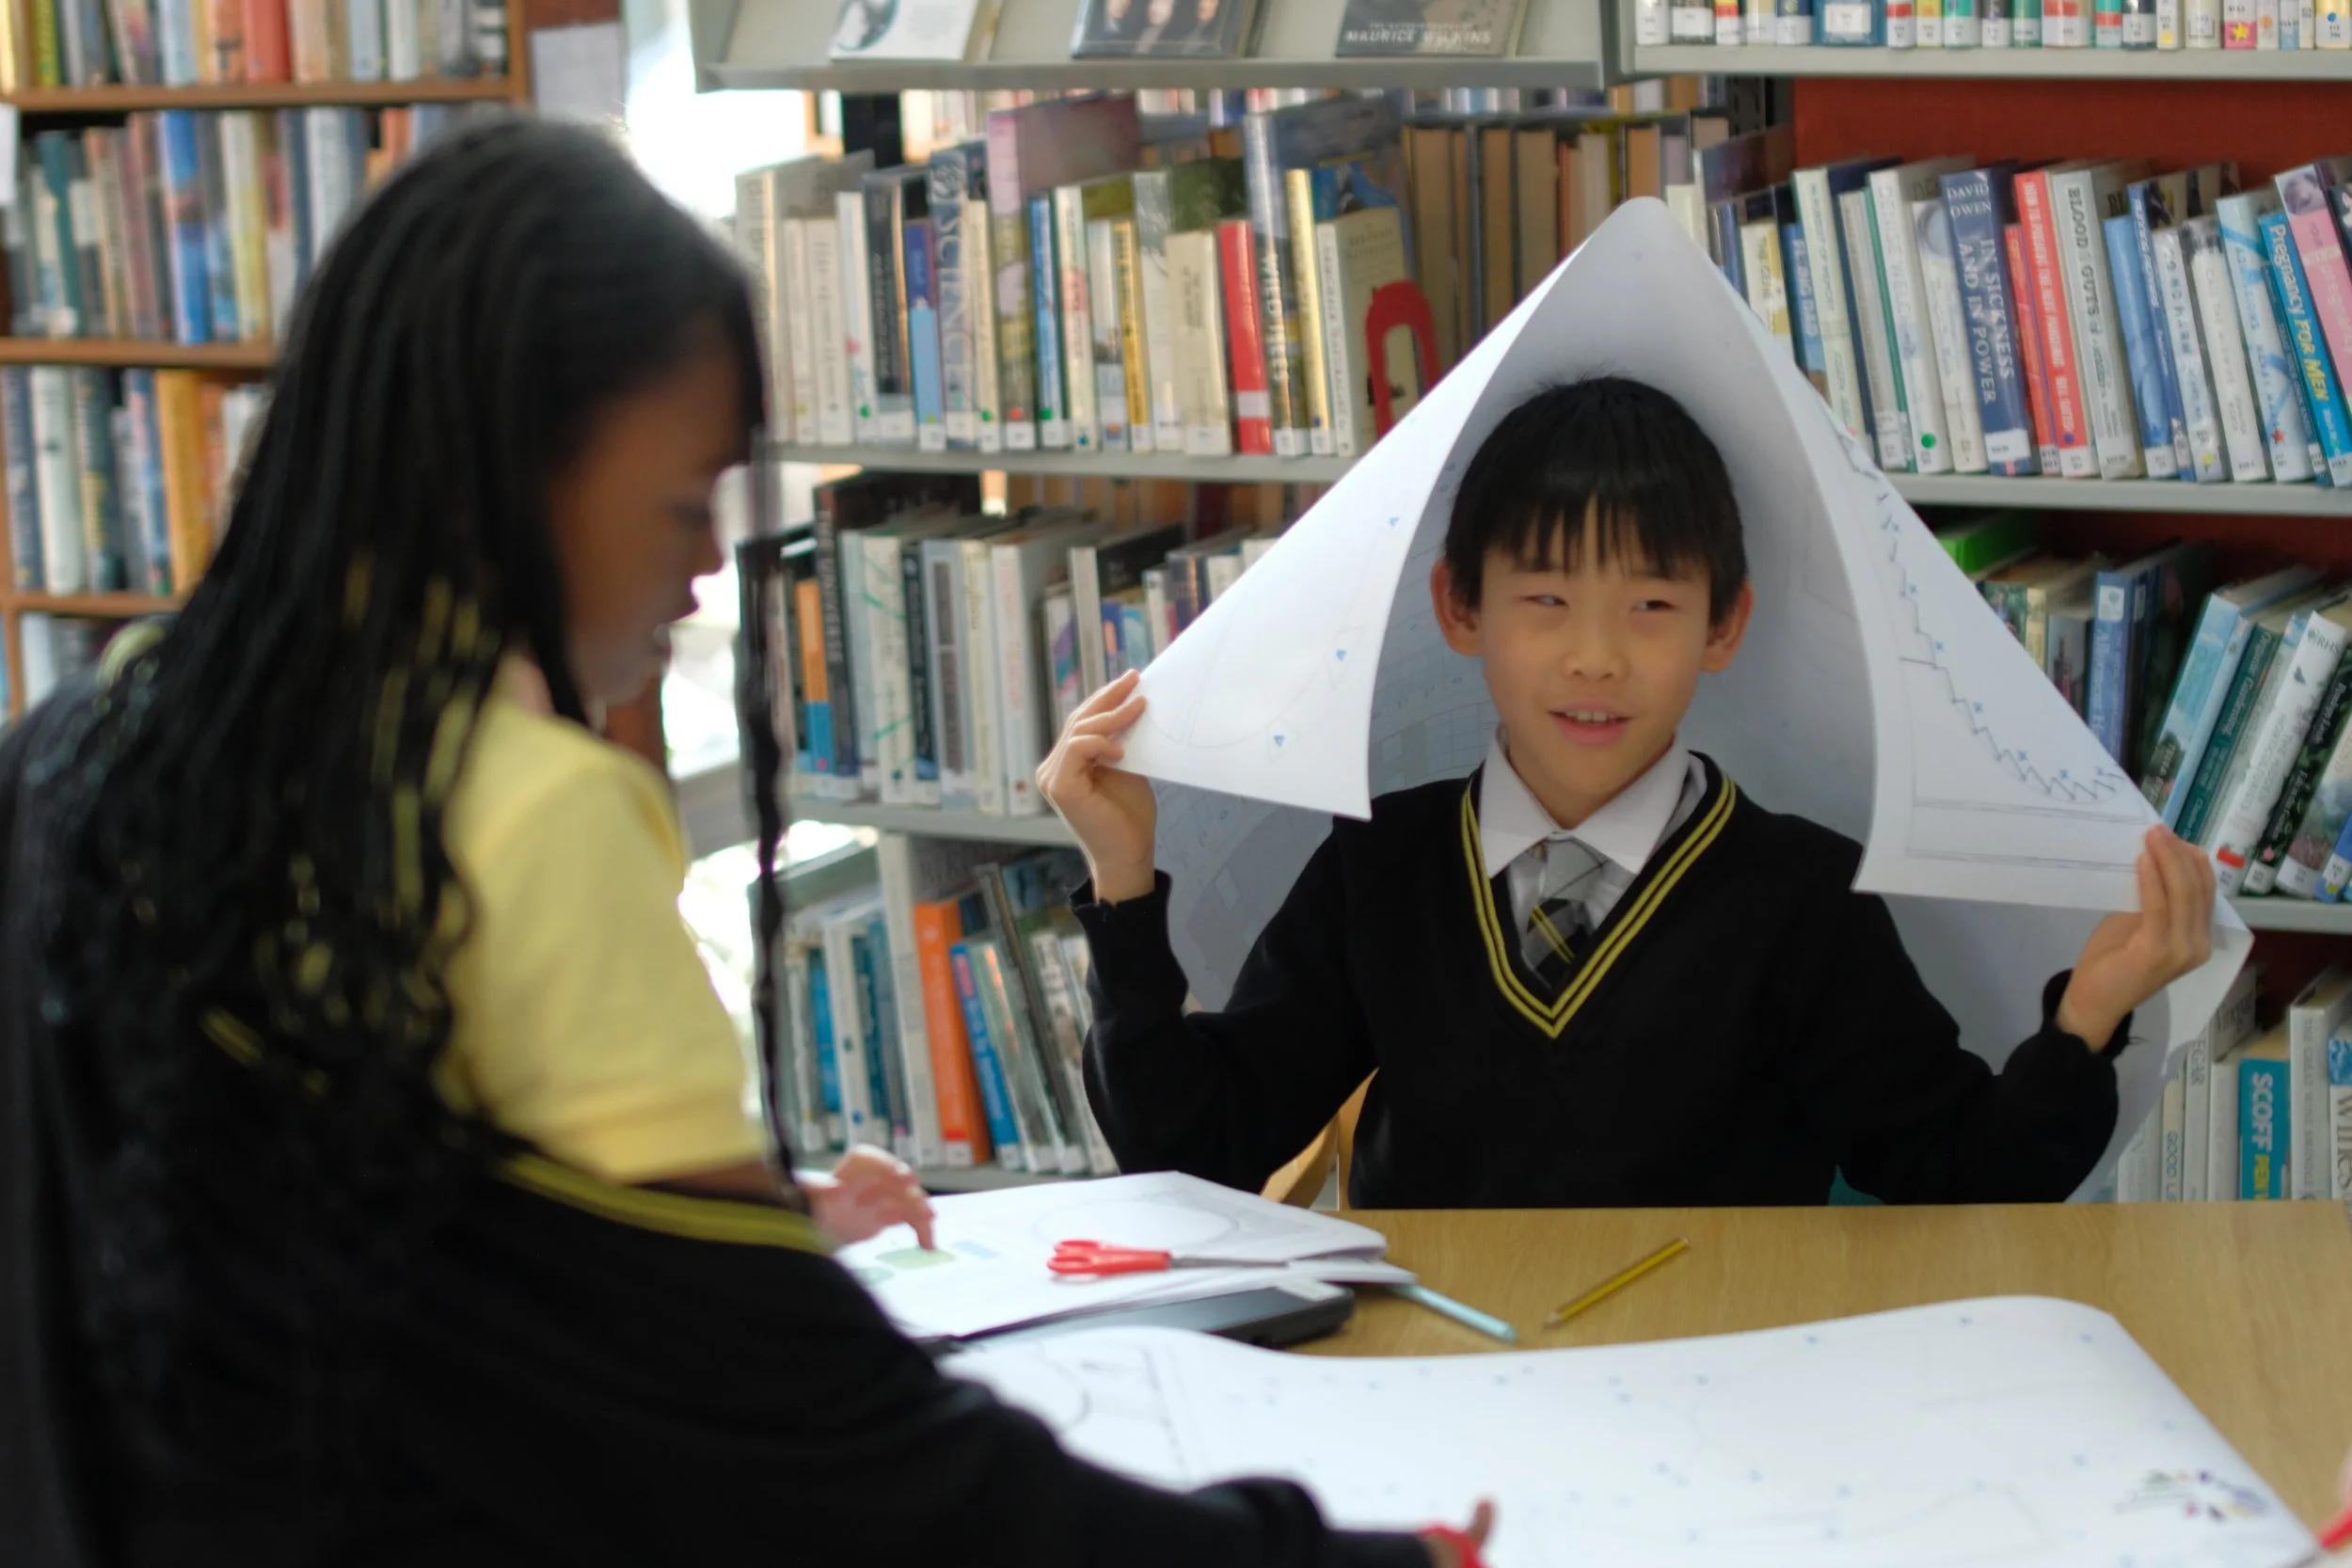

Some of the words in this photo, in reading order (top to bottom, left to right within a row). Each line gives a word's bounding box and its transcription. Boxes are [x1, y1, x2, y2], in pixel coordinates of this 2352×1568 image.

[1345, 29, 1415, 43] MAURICE
[1422, 29, 1492, 43] WILKINS
[1946, 182, 1990, 200] DAVID
[1949, 199, 1993, 218] OWEN
[1959, 241, 1980, 289] AND
[1979, 238, 1997, 263] IN
[2067, 186, 2090, 249] BLOOD
[2080, 264, 2101, 316] GUTS
[2268, 224, 2312, 316] Pregnancy
[1967, 294, 1985, 319] IN
[1984, 272, 2015, 379] SICKNESS
[2294, 318, 2316, 355] FOR
[1973, 325, 1997, 404] POWER
[2302, 356, 2332, 404] MEN
[2316, 636, 2340, 656] RHS
[2219, 673, 2255, 738] Gardening
[2302, 1018, 2312, 1041] THE
[2302, 1046, 2313, 1085] GREAT
[2249, 1071, 2275, 1151] SCOFF
[2166, 1131, 2178, 1179] GOOD
